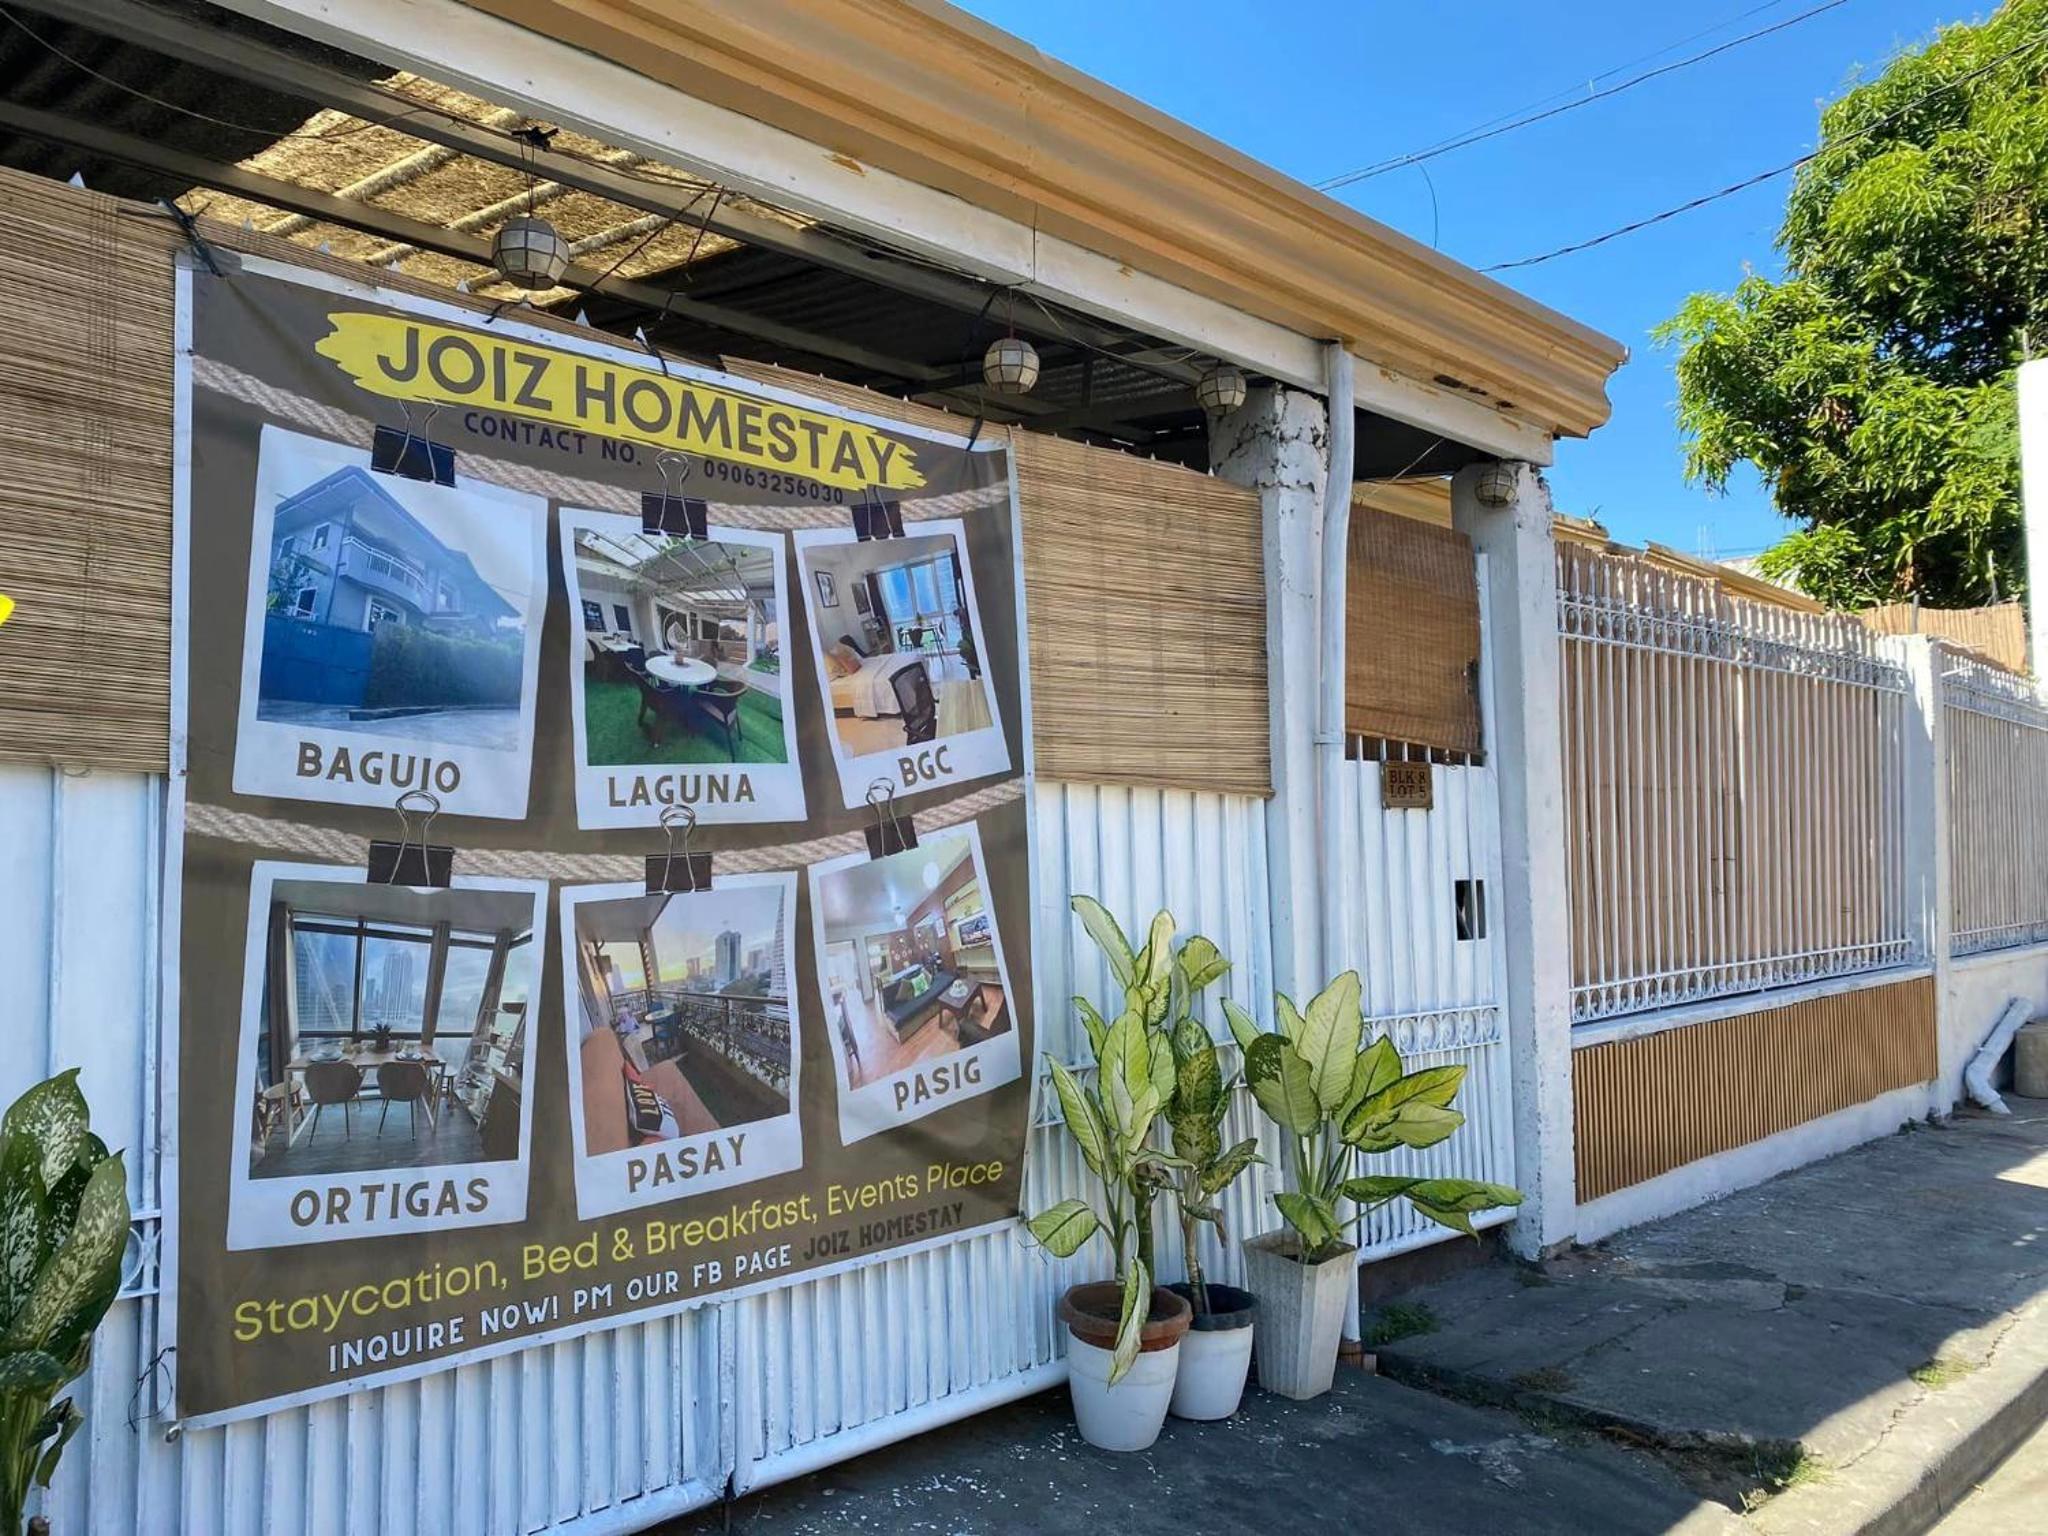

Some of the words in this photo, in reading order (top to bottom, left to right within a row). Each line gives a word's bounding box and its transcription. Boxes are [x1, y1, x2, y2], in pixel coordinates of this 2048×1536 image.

[377, 326, 553, 412] JOIZ
[575, 365, 896, 484] HOMESTAY
[464, 412, 587, 454] CONTACT
[601, 438, 642, 466] NO.
[703, 459, 843, 504] 09063256030
[296, 741, 461, 793] BAGUIO
[608, 773, 755, 807] LAGUNA
[898, 744, 953, 788] BGC
[1390, 769, 1415, 785] BLK
[1419, 771, 1425, 784] 8
[1390, 785, 1415, 798] LOT
[1419, 786, 1425, 798] 5
[893, 1055, 981, 1111] PASIG
[627, 1133, 746, 1193] PASAY
[290, 1178, 489, 1227] ORTIGAS
[234, 1259, 508, 1341] Staycation,
[523, 1232, 598, 1280] Bed
[611, 1227, 635, 1262] &
[646, 1197, 818, 1255] Breakfast,
[828, 1172, 919, 1217] Events
[927, 1160, 1004, 1193] Place
[329, 1316, 464, 1373] INQUIRE
[480, 1295, 558, 1336] NOW!
[573, 1283, 612, 1314] PM
[626, 1269, 679, 1301] OUR
[692, 1260, 722, 1289] FB
[735, 1243, 792, 1279] PAGE
[803, 1229, 852, 1261] JOIZ
[859, 1202, 965, 1248] HOMESTAY
